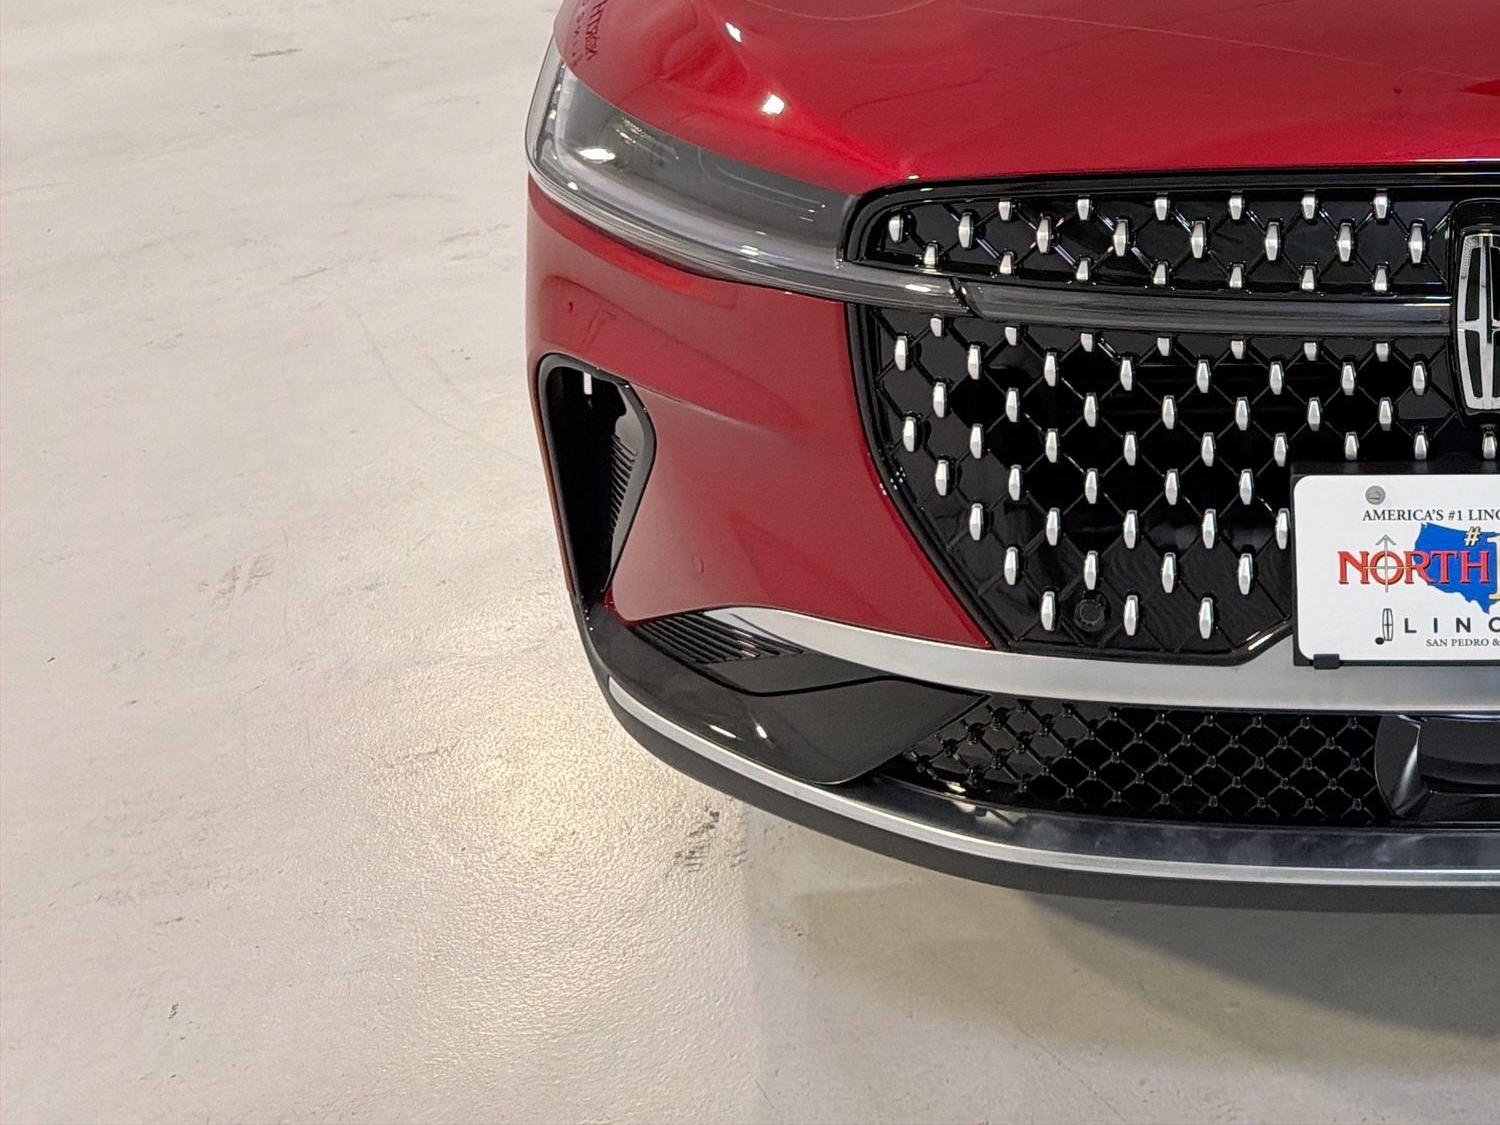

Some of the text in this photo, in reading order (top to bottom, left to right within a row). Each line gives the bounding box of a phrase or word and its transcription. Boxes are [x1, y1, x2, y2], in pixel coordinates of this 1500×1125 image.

[1362, 509, 1444, 521] AMERICA'S
[1447, 509, 1464, 521] #1
[1337, 549, 1490, 585] NORTH
[1425, 637, 1449, 647] SAN
[1451, 637, 1490, 647] PEDRO
[1492, 637, 1500, 647] &
